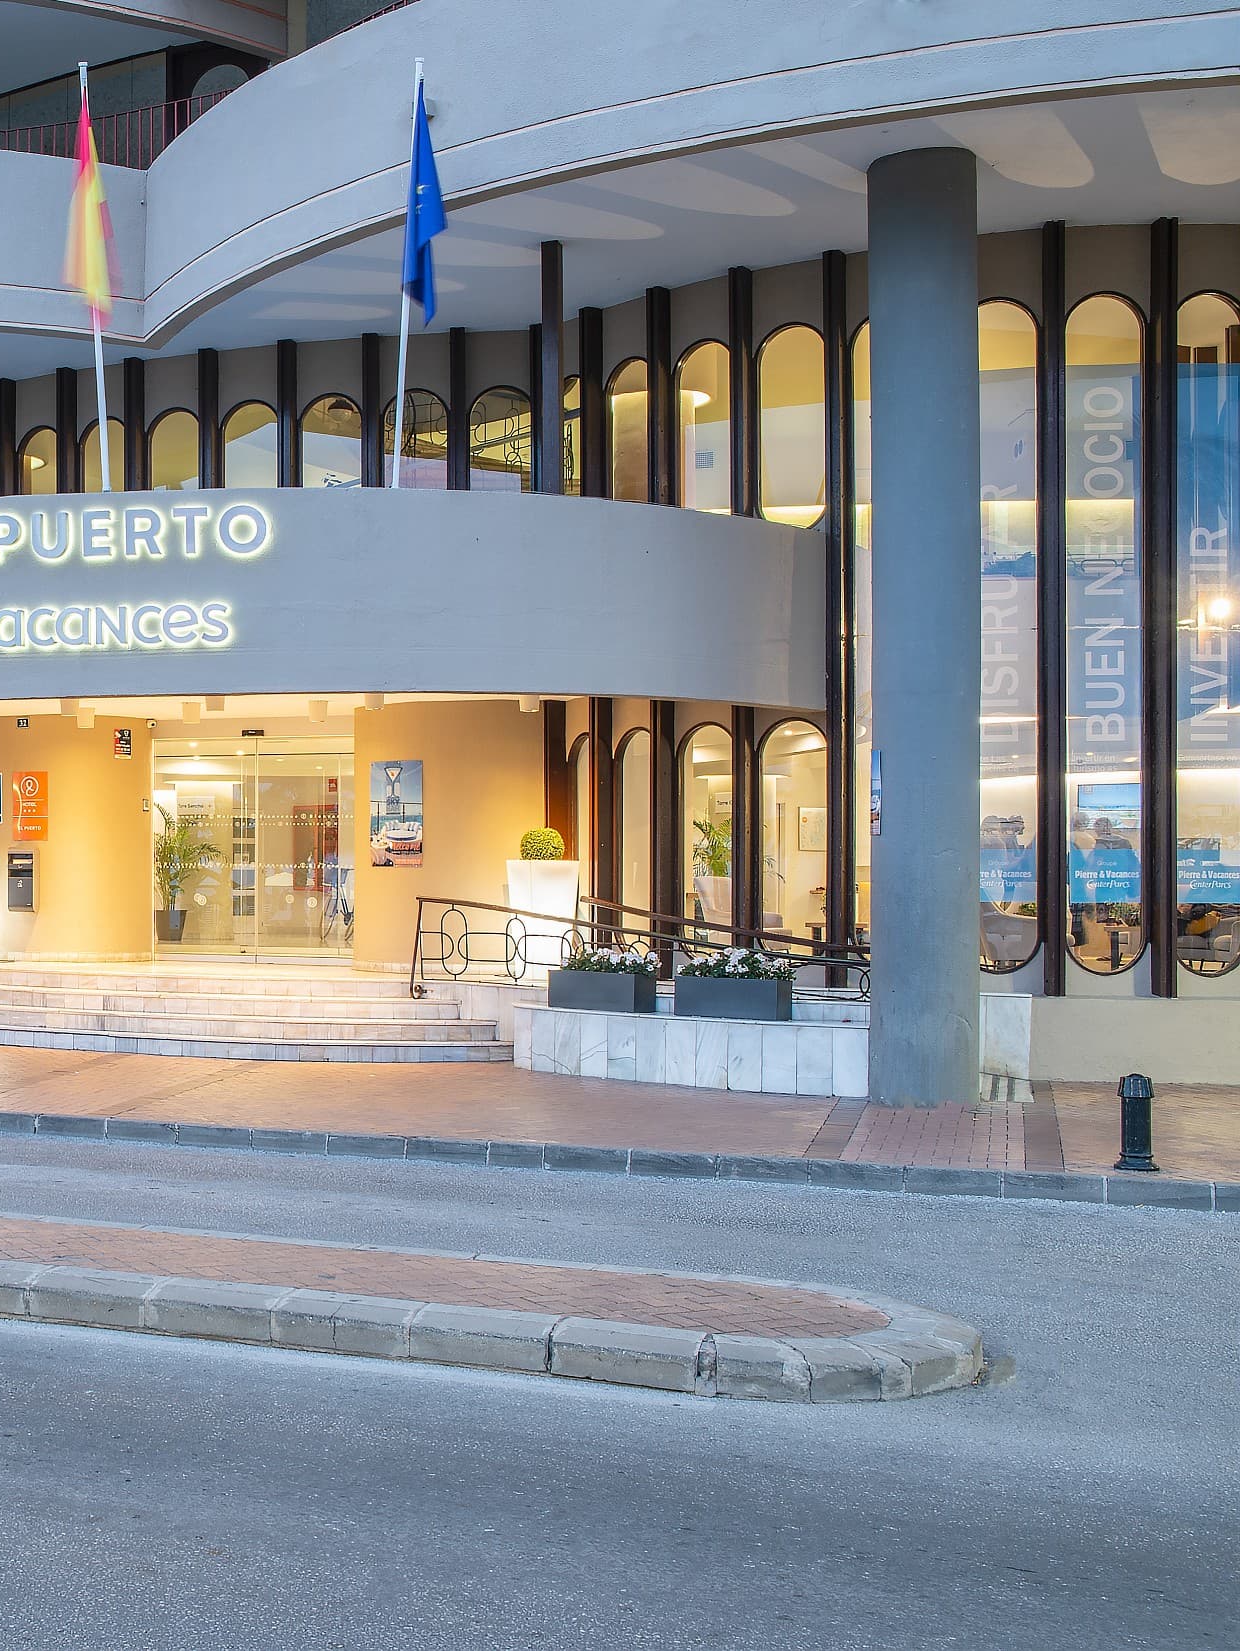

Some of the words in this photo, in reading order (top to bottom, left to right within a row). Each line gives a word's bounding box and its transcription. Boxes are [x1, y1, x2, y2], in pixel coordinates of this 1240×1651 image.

[1083, 385, 1125, 596] NEOCIO
[981, 484, 1019, 743] DISFRUAR
[1085, 617, 1126, 742] BUEN
[1075, 870, 1098, 879] Pierre
[1106, 870, 1140, 878] Vacances
[1178, 870, 1201, 879] Pierre
[1208, 871, 1240, 879] Vacances
